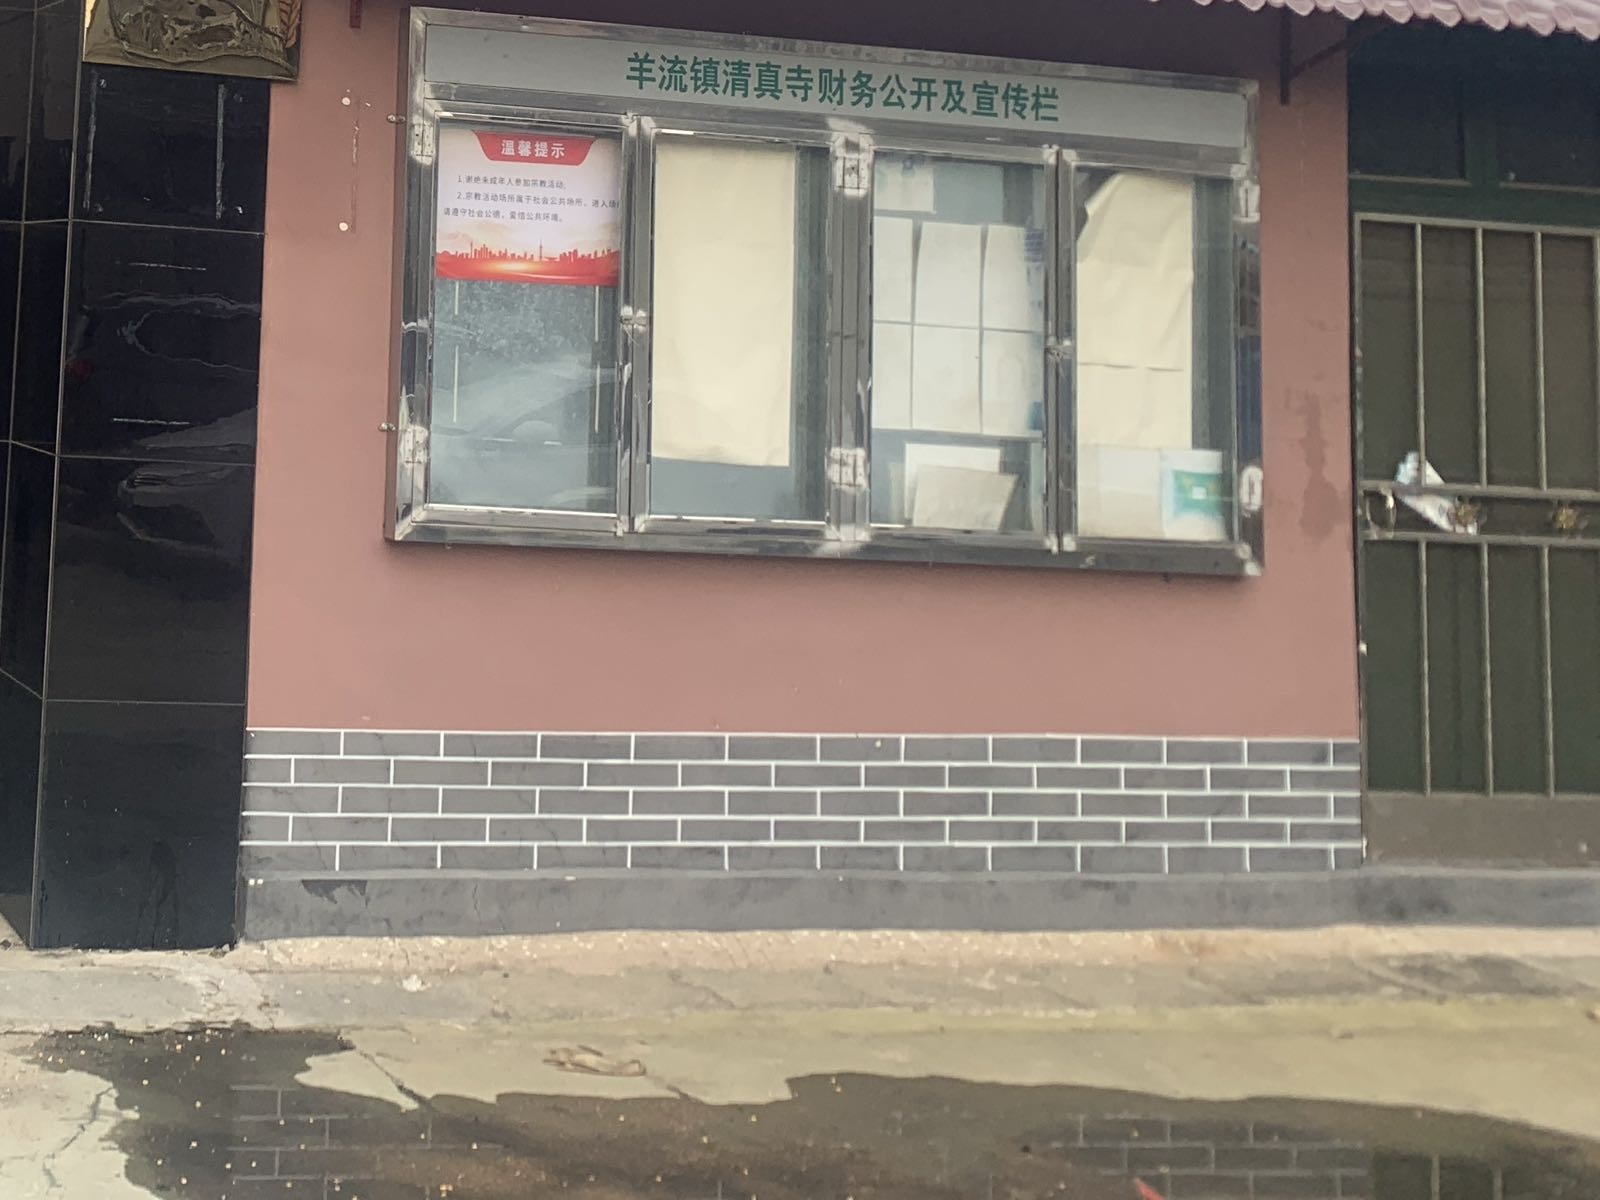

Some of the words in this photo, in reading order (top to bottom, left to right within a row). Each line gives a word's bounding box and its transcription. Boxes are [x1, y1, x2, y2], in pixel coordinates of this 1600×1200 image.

[625, 51, 1060, 123] 羊流镇清真寺财务公开及宣传栏
[501, 139, 566, 159] 温馨提示
